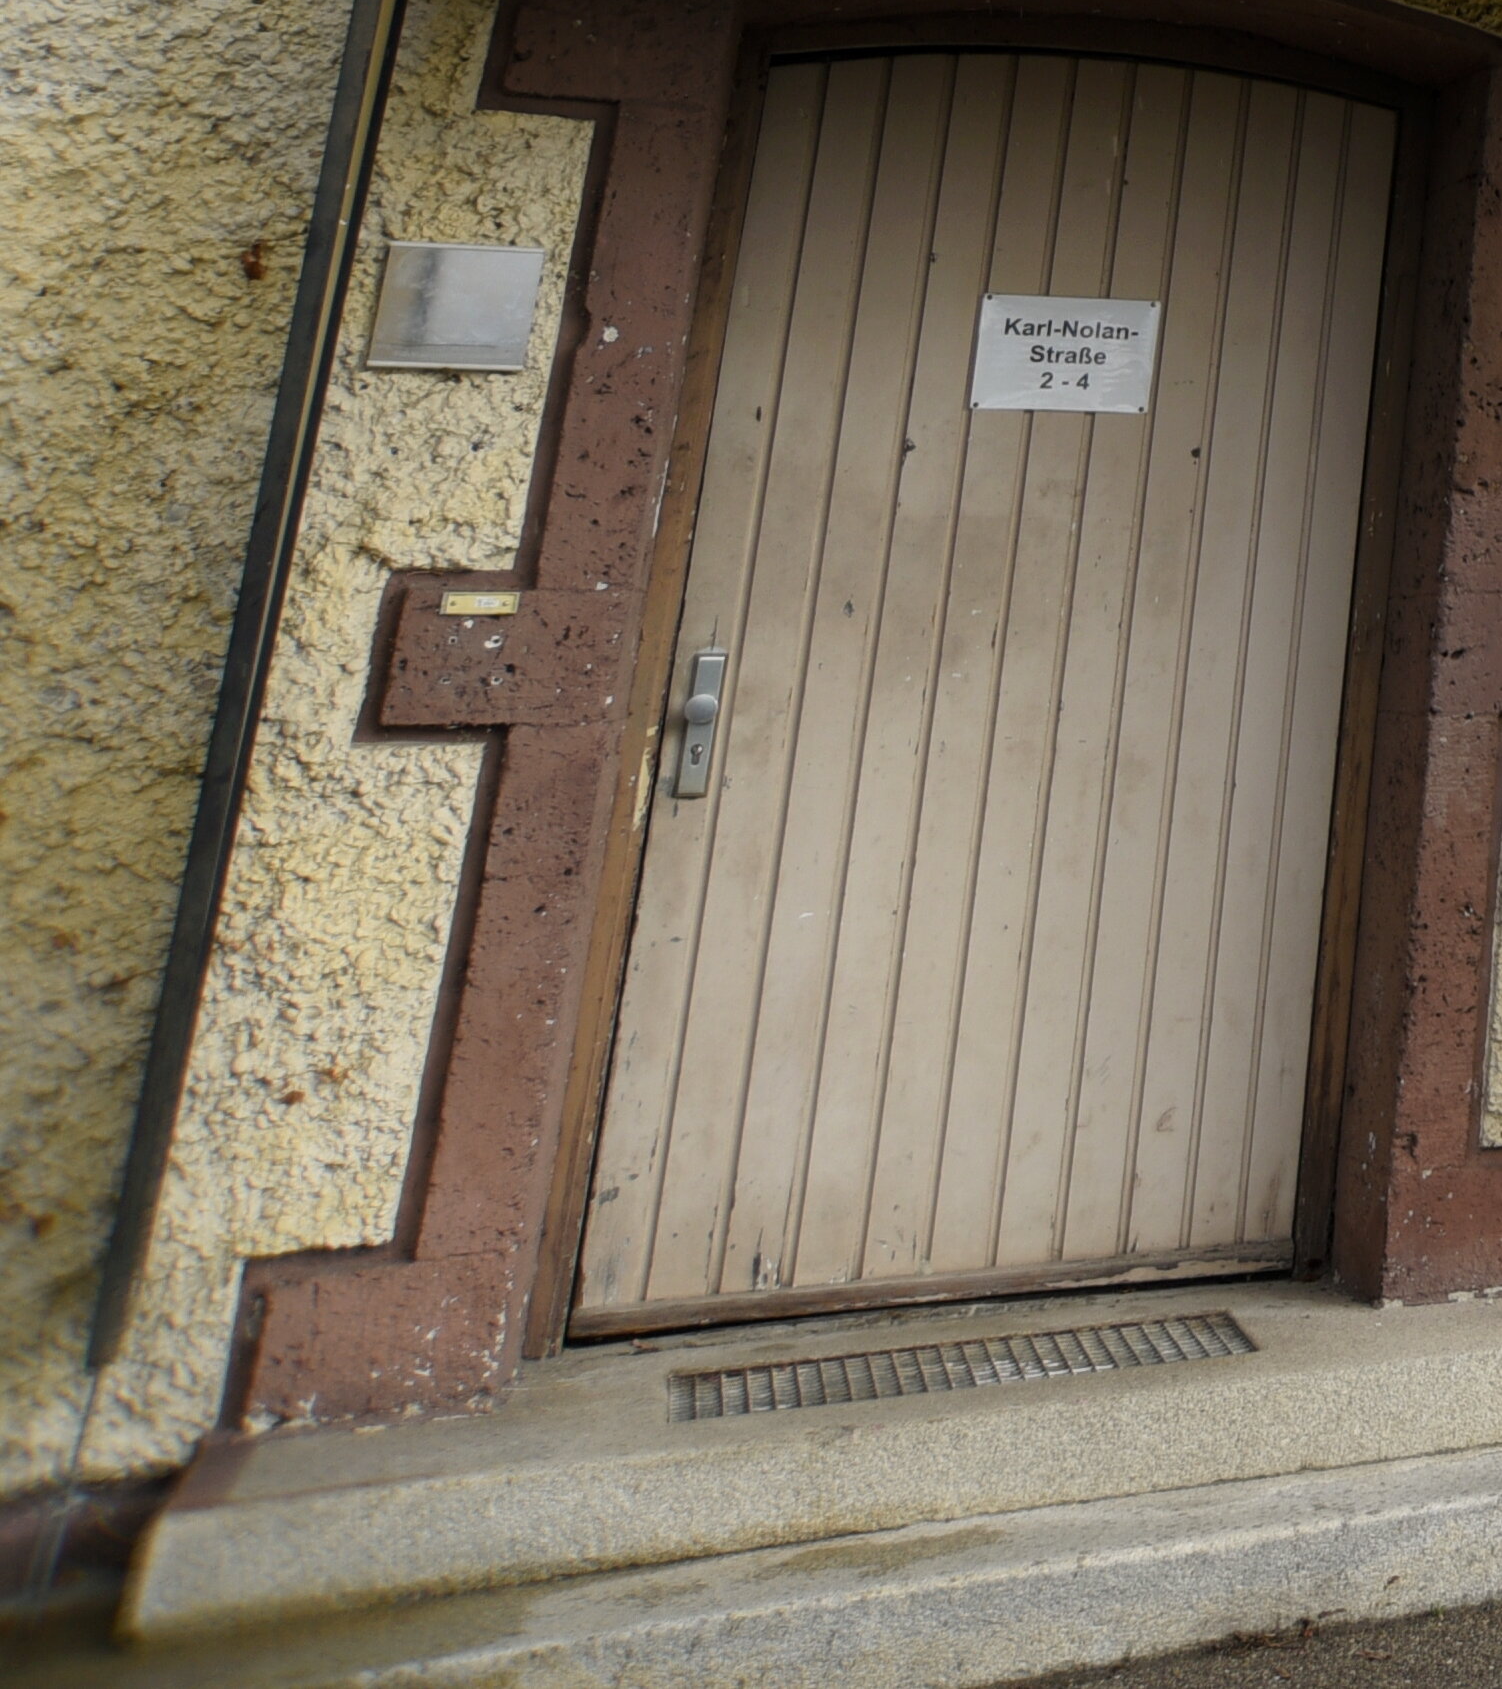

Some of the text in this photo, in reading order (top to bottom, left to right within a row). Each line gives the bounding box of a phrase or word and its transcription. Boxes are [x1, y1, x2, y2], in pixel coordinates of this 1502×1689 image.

[1004, 318, 1139, 340] Karl-Nolan-
[1030, 345, 1107, 365] Straße
[1040, 372, 1054, 389] 2
[1076, 373, 1090, 390] 4
